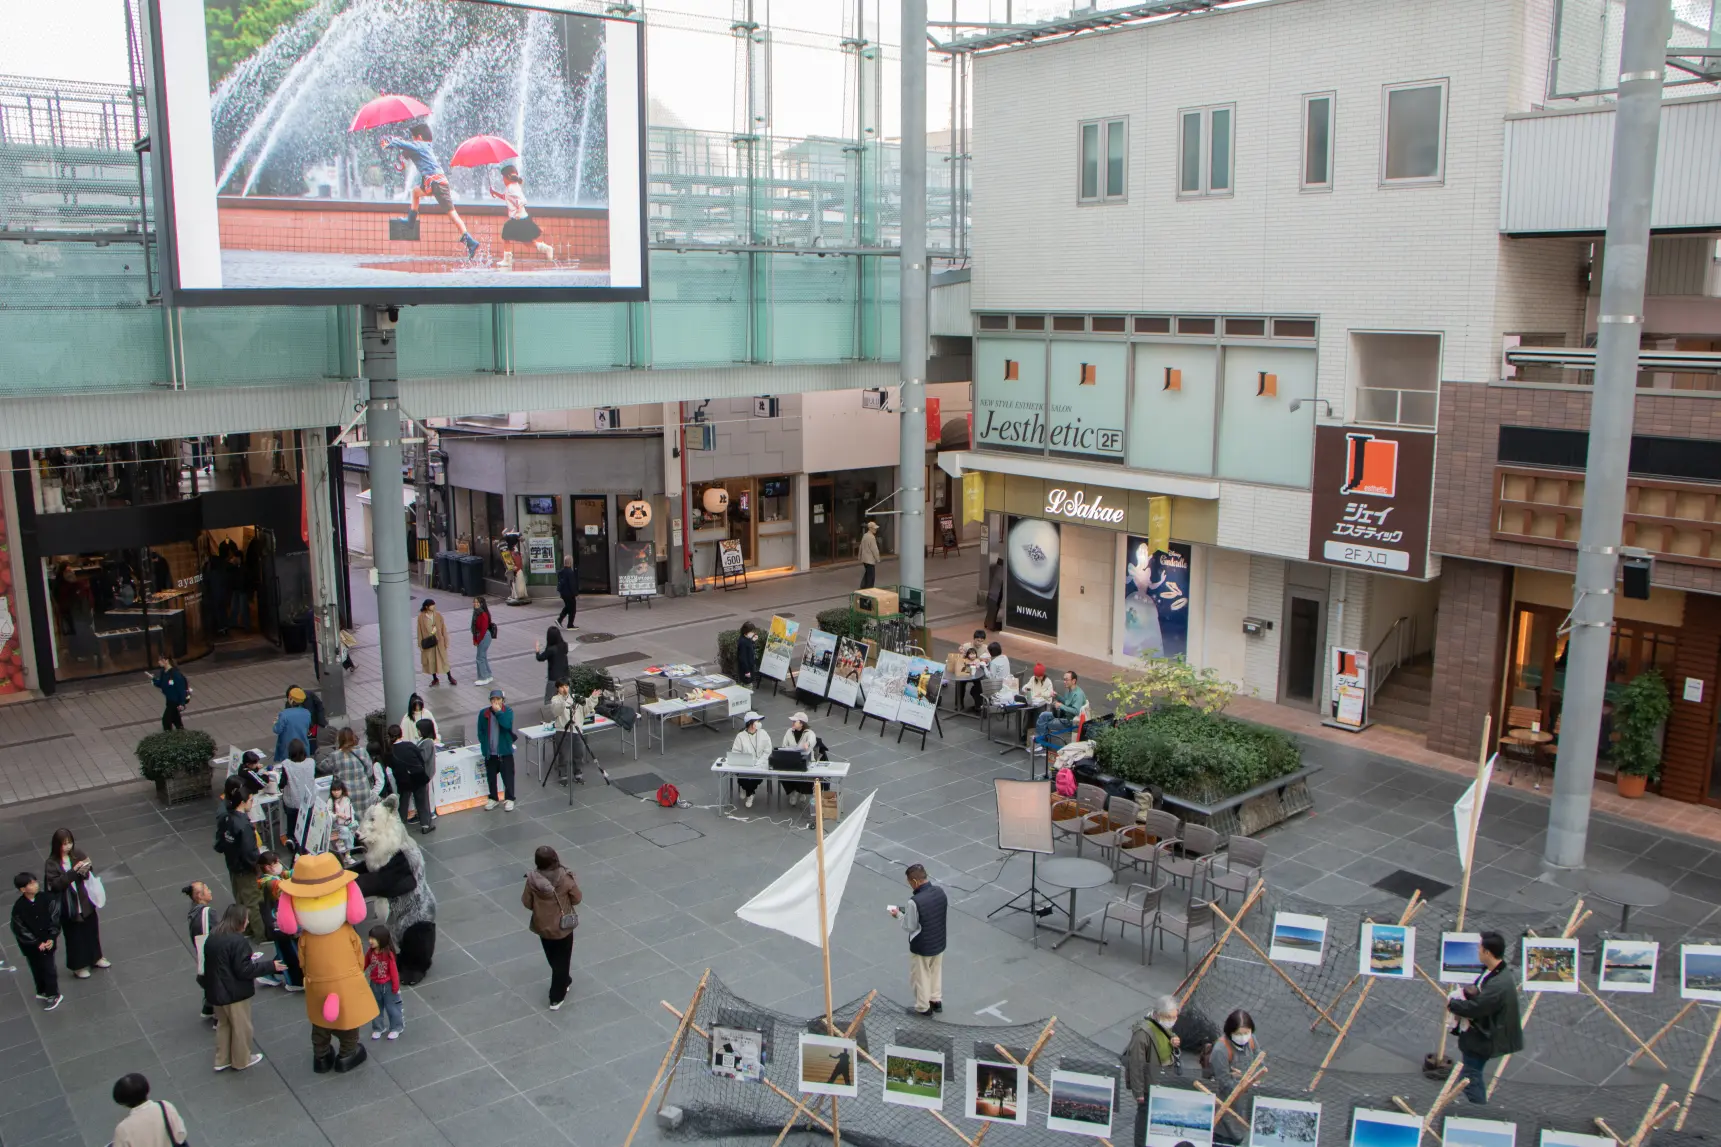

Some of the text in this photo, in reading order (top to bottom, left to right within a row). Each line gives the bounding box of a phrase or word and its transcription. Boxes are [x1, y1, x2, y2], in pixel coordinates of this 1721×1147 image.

[980, 399, 994, 407] NEW
[995, 400, 1014, 408] STYLE
[1051, 404, 1073, 413] SALON
[979, 410, 1119, 449] J-esthetic 2F
[1363, 484, 1388, 494] esthetic
[1343, 502, 1395, 525] ジェイ
[1332, 522, 1403, 543] エステティック
[530, 546, 553, 558] 学割
[1344, 547, 1388, 565] 2F 入口
[1016, 605, 1048, 620] NIWAKA
